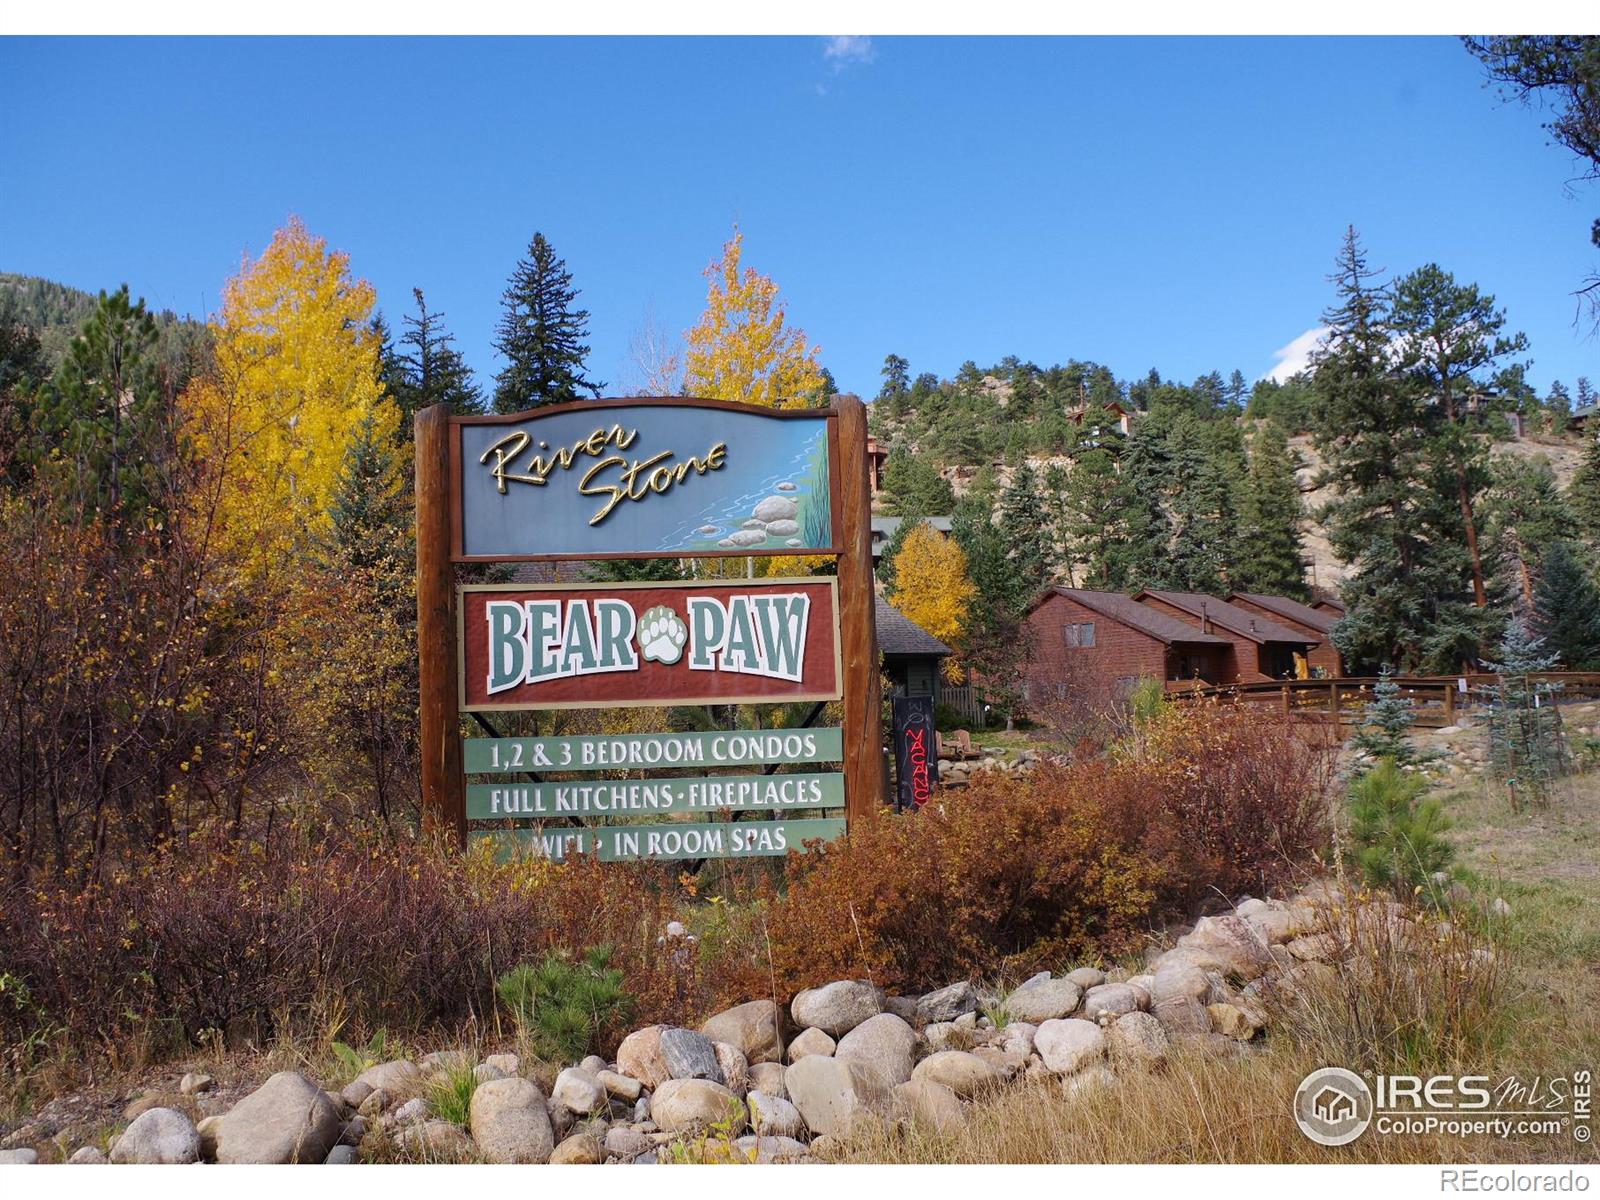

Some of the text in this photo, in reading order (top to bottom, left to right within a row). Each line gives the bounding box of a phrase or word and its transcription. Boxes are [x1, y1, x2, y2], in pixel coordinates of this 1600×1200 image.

[480, 423, 638, 495] River
[578, 441, 728, 526] Stone
[486, 592, 811, 696] BEAR PAW
[490, 734, 817, 771] 1,2 & 3 BEDROOM CONDOS
[490, 779, 823, 814] FULL KITCHENS FIREPLACES
[614, 831, 640, 857] IN
[648, 829, 722, 855] ROOM
[731, 826, 787, 852] SPAS
